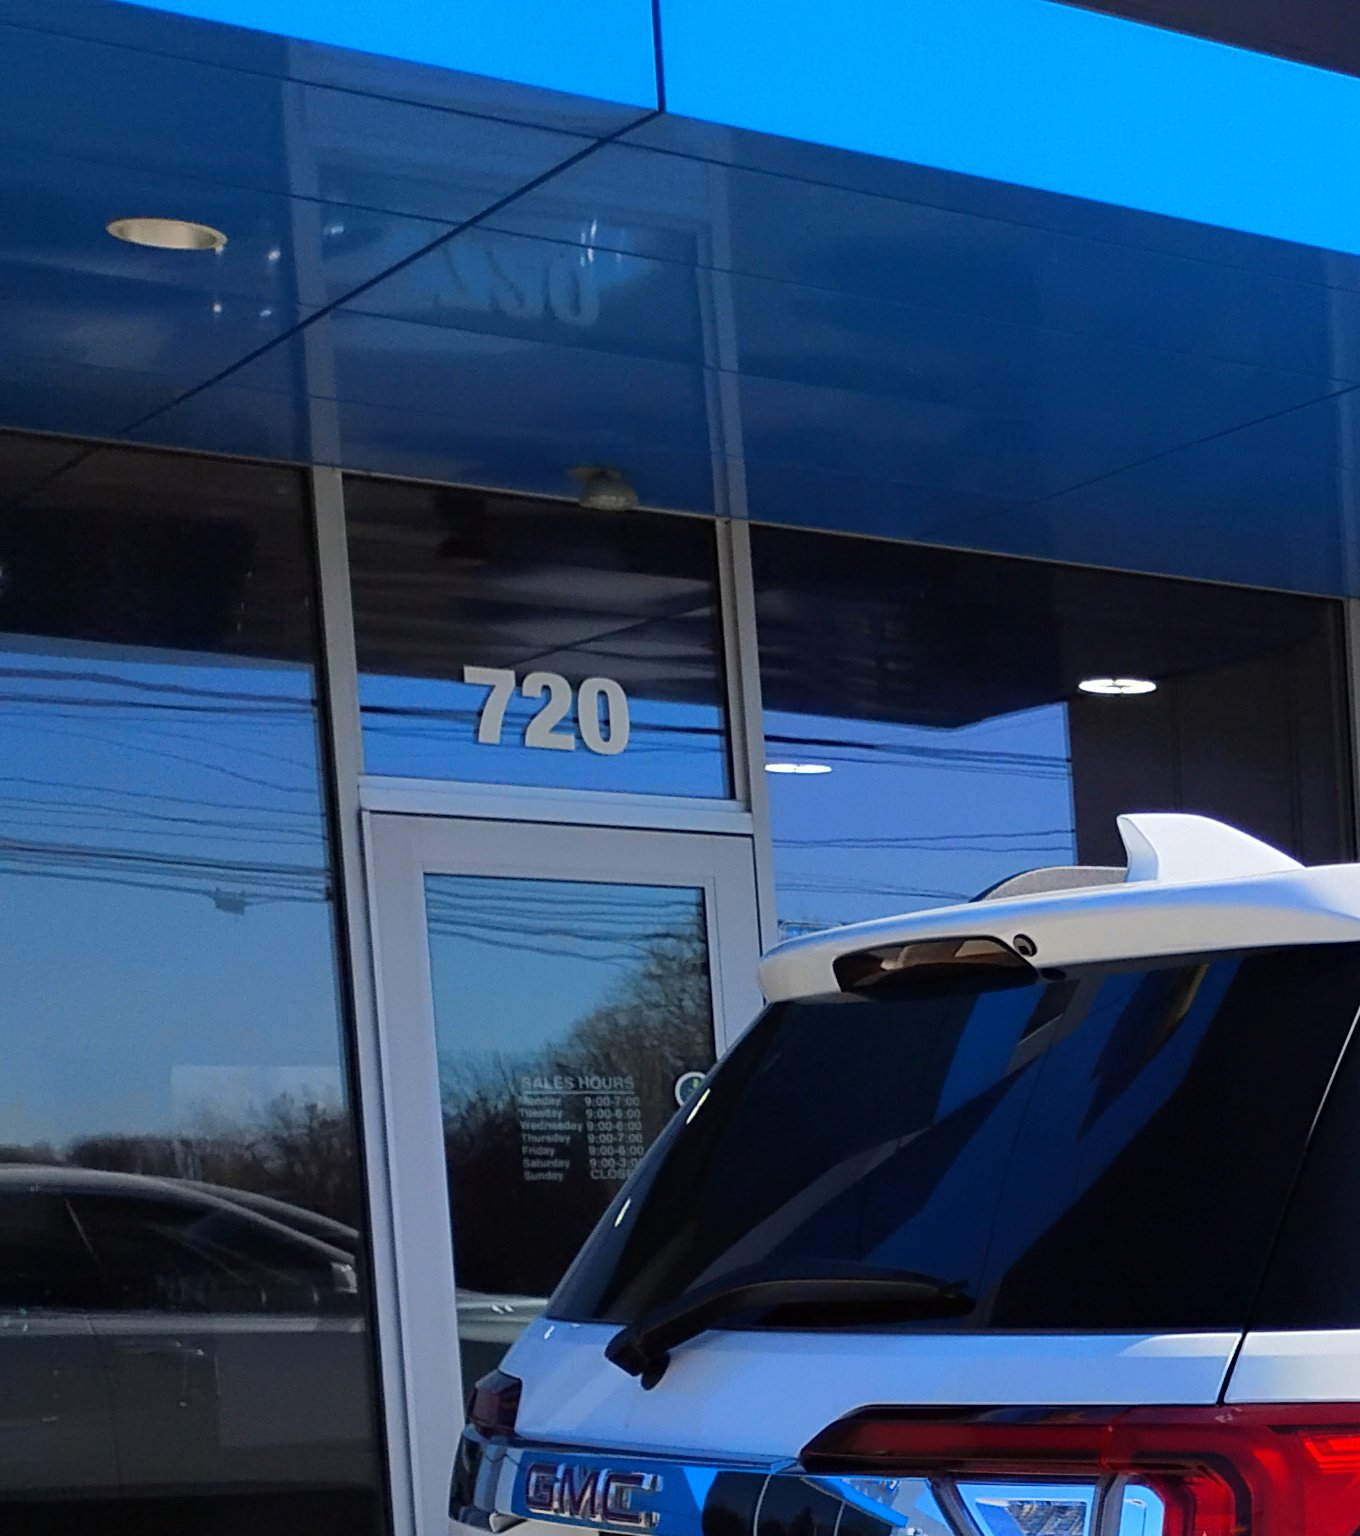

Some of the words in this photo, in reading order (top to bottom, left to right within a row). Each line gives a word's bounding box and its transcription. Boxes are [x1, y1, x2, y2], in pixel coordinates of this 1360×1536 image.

[463, 665, 630, 755] 720
[521, 1075, 574, 1090] SALES
[579, 1076, 634, 1090] HOURS
[520, 1120, 583, 1132] Wednesday
[521, 1145, 555, 1157] Friday
[522, 1158, 571, 1169] Saturday
[523, 1170, 564, 1182] Sunday
[525, 1462, 663, 1529] GMC
